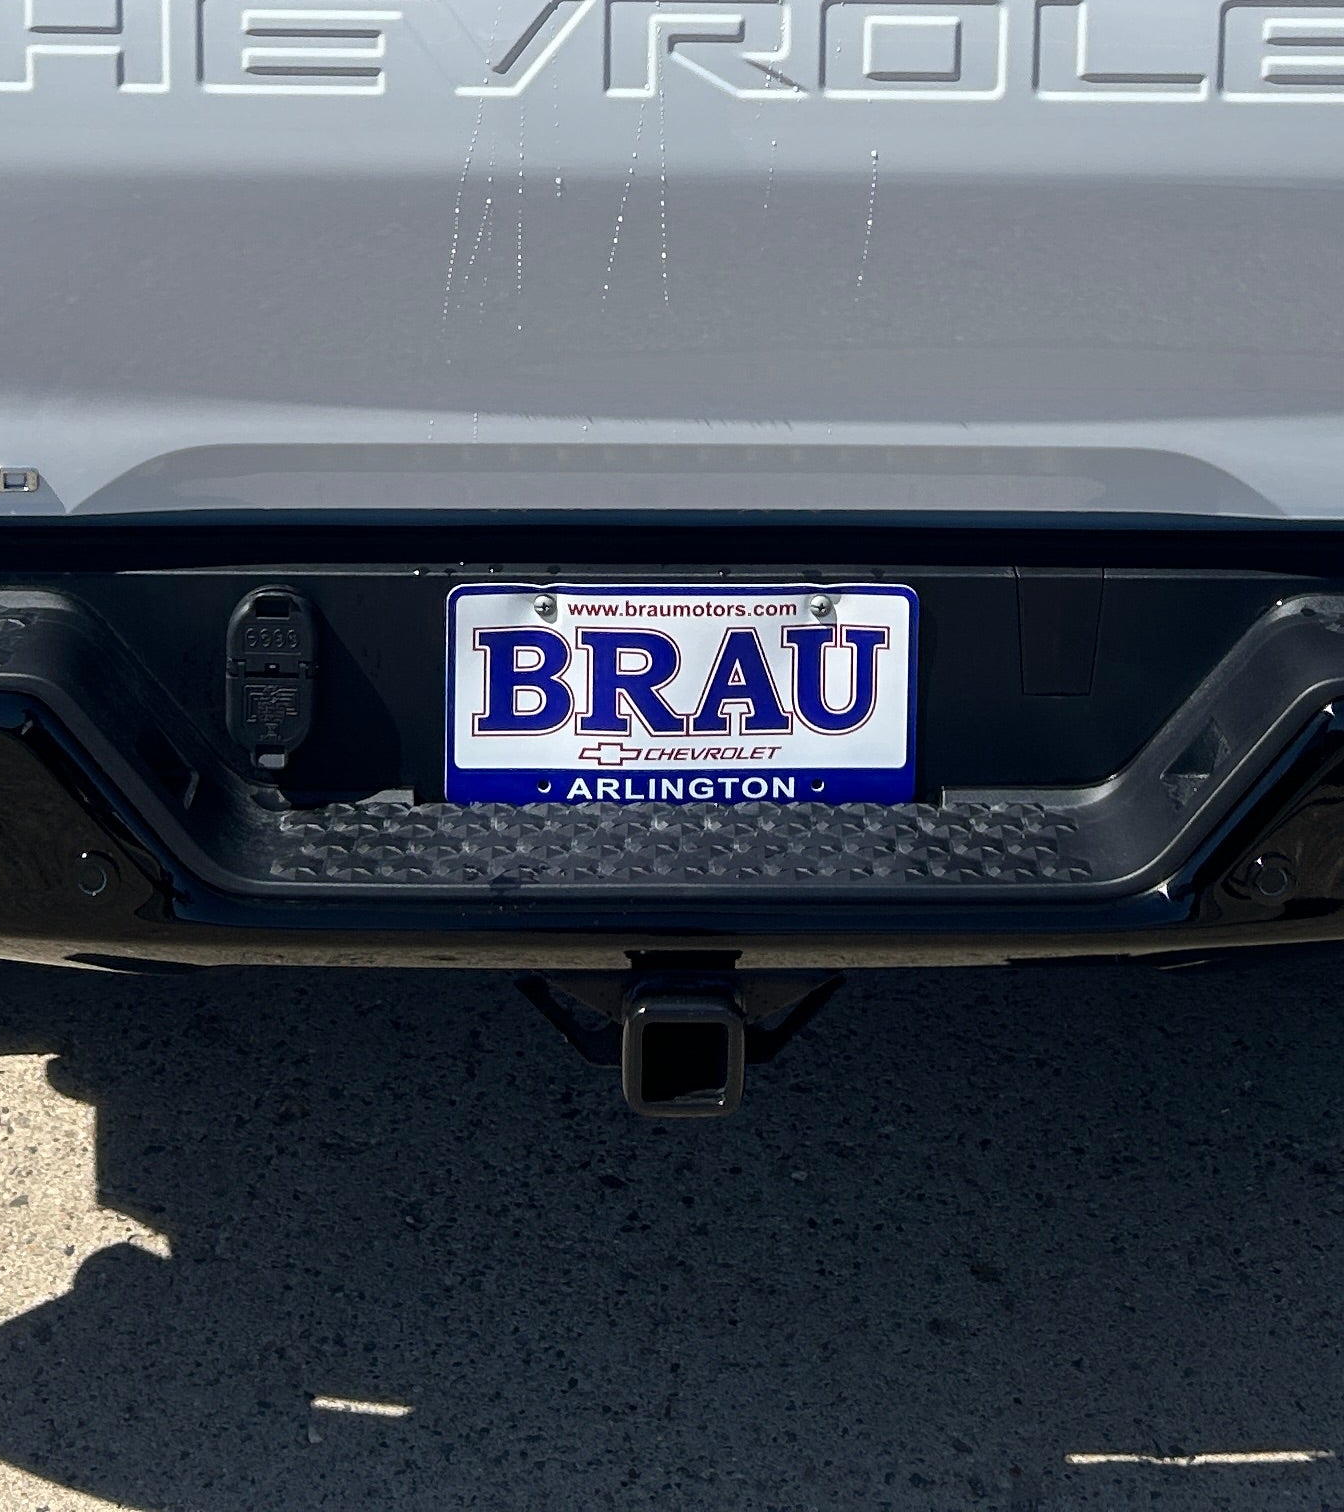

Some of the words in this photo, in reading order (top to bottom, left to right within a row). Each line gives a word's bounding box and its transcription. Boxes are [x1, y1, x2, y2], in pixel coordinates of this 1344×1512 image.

[567, 600, 798, 618] www.braumotors.com
[472, 624, 891, 738] BRAU
[643, 745, 783, 762] CHEVROLET
[565, 776, 796, 801] ARLINGTON
